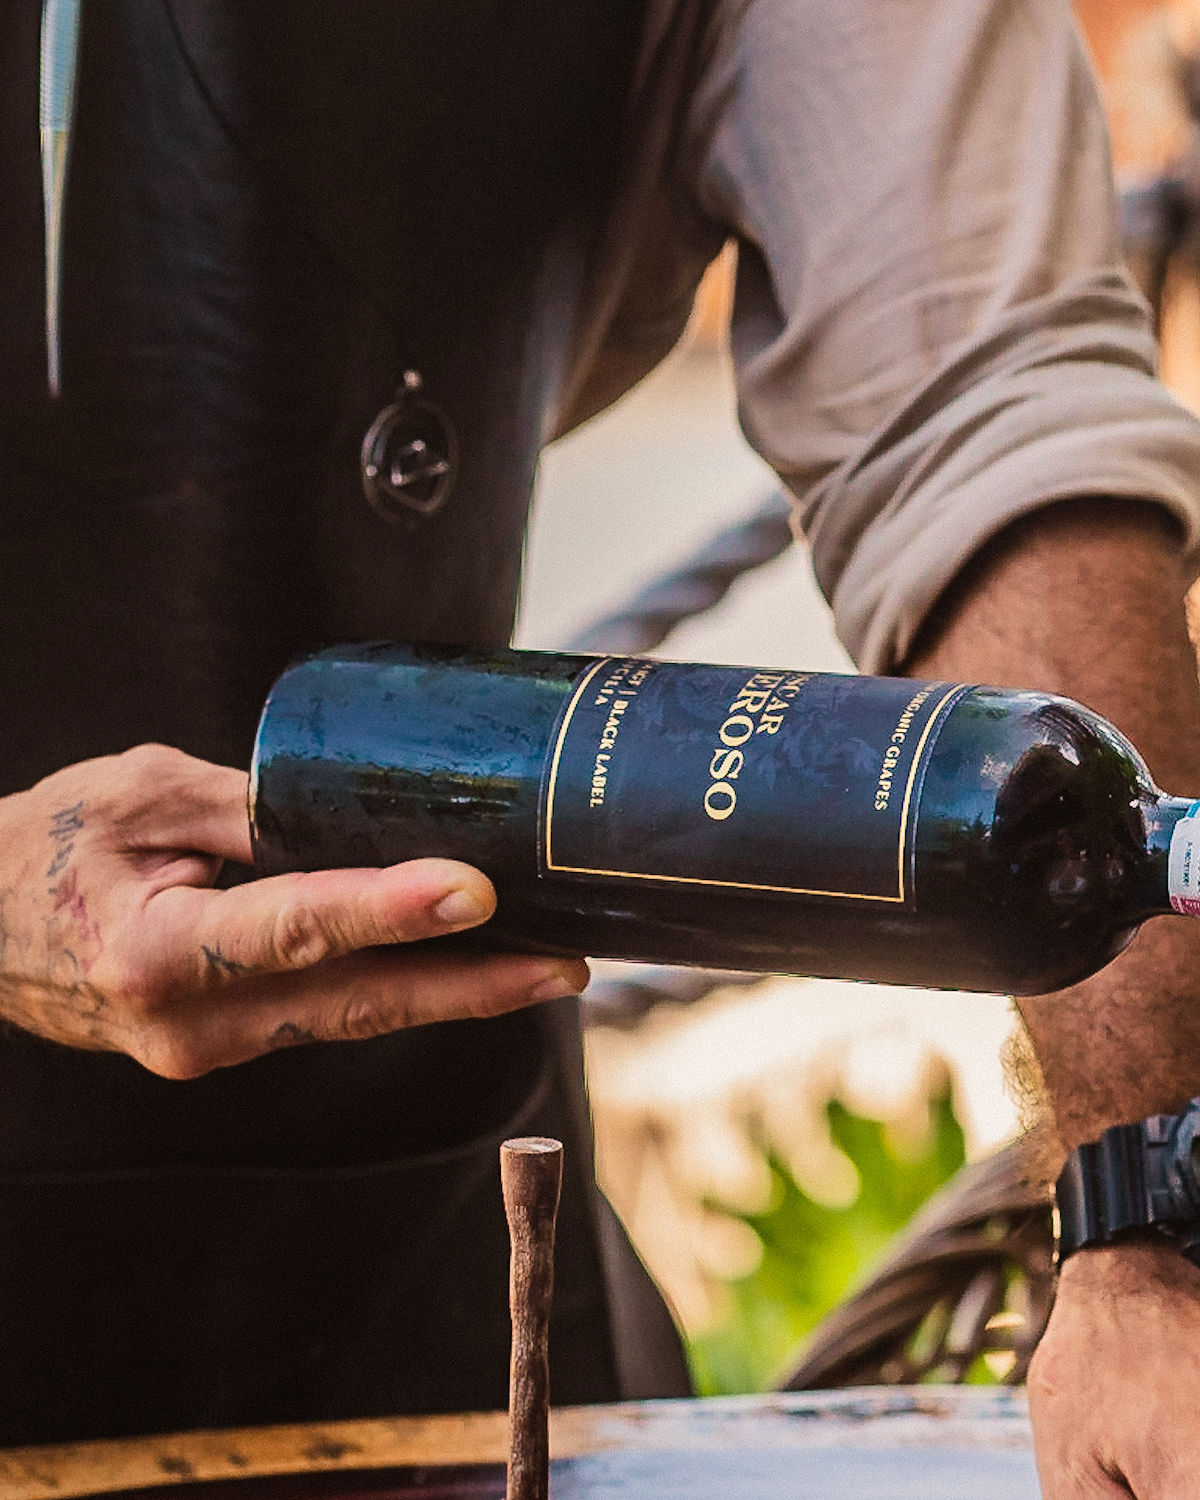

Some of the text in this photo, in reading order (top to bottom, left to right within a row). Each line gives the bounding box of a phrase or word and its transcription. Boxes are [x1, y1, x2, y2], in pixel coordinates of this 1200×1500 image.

[589, 699, 629, 808] BLACK LABEL
[704, 672, 784, 821] EROSO
[874, 745, 901, 811] GRAPES
